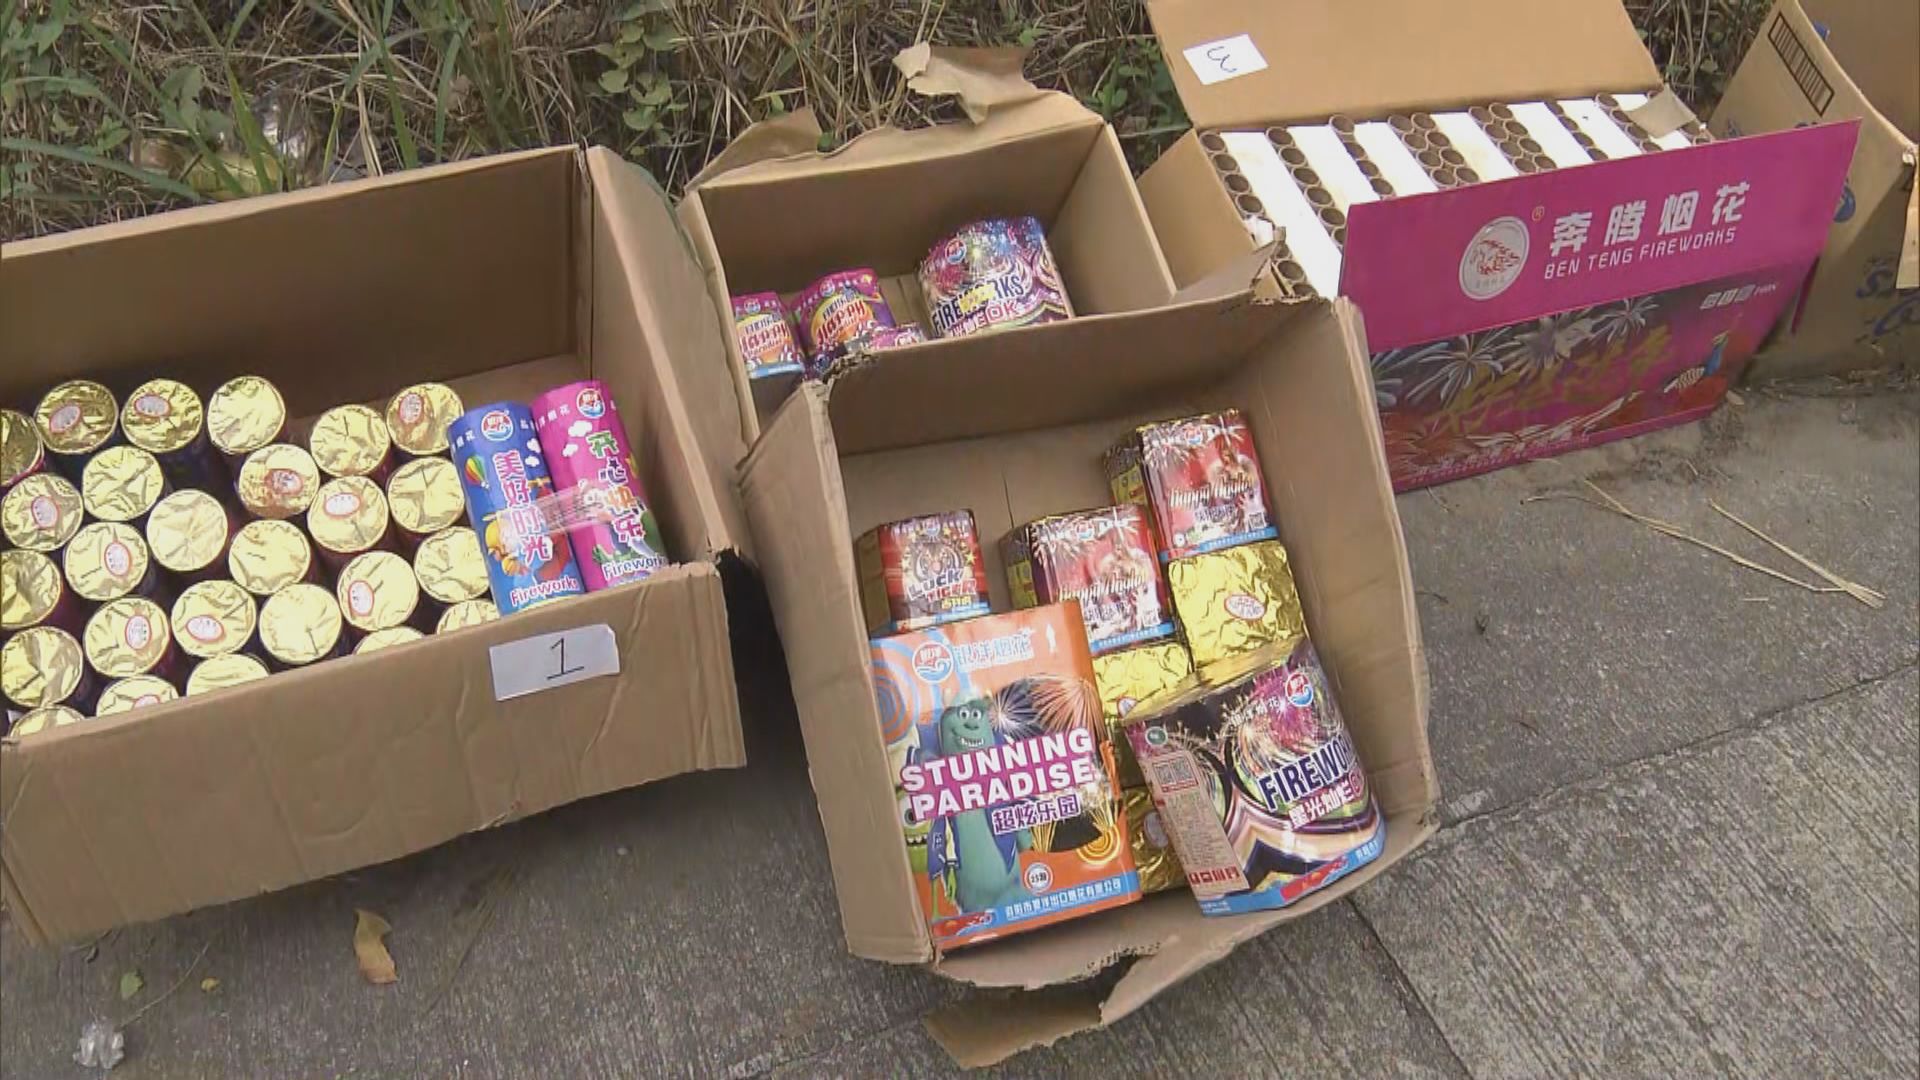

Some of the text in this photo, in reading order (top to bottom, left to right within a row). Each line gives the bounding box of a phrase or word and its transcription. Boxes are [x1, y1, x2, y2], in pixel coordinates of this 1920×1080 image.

[1206, 46, 1237, 72] 3
[1551, 182, 1749, 256] 奔腾烟花
[1544, 226, 1737, 280] BEN TENG FIREWORKS
[547, 638, 584, 680] 1
[901, 727, 1093, 792] STUNNING
[911, 756, 1095, 822] PARADISE
[992, 793, 1082, 834] 超炫乐园
